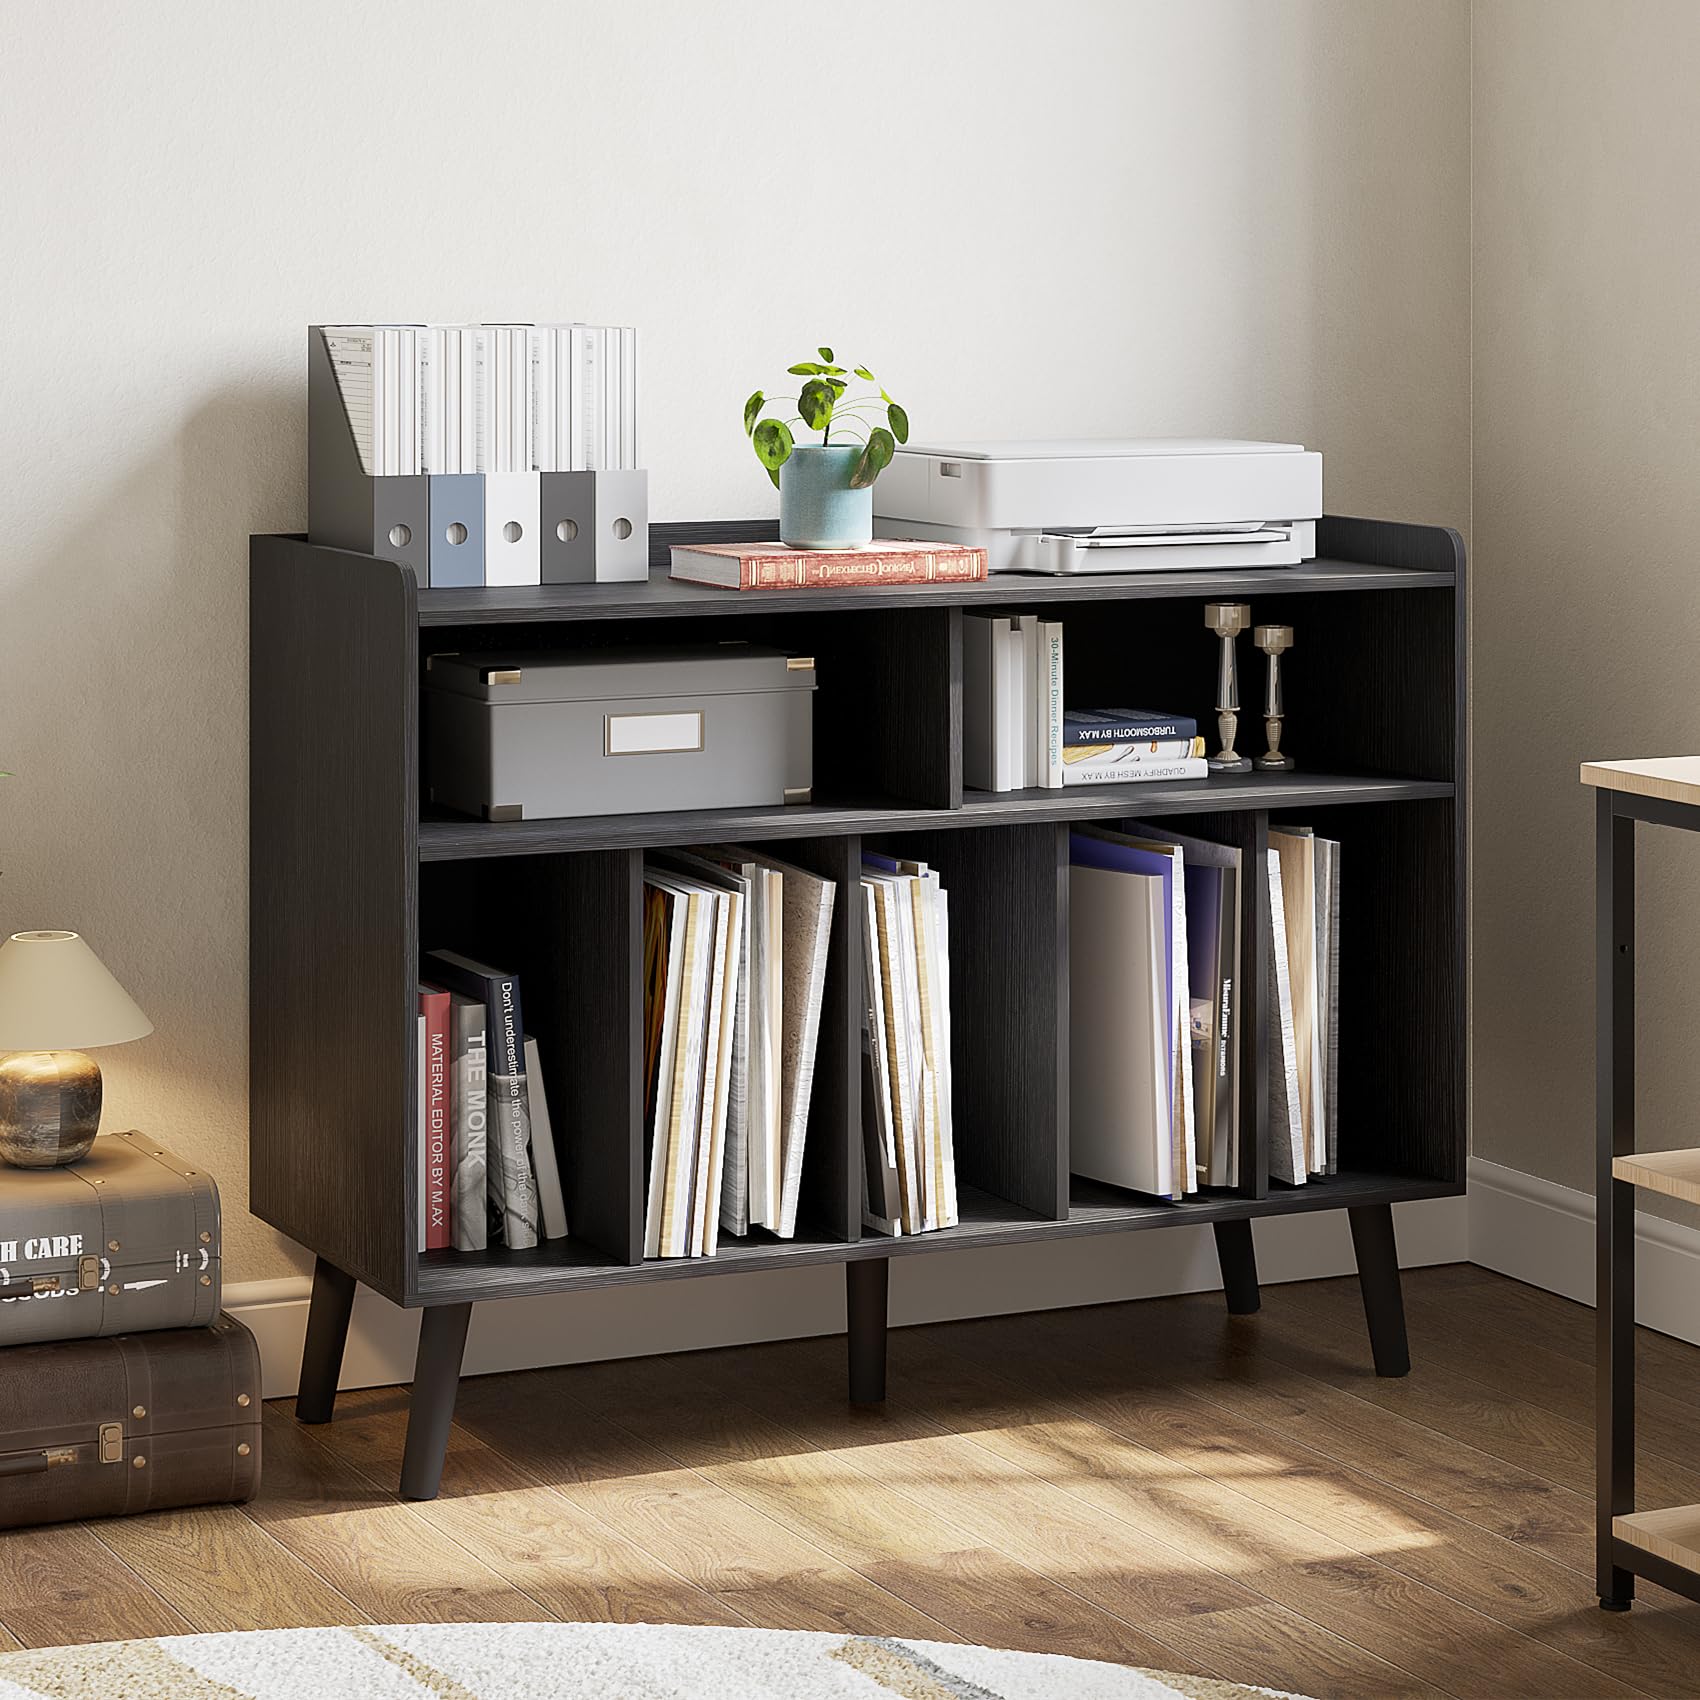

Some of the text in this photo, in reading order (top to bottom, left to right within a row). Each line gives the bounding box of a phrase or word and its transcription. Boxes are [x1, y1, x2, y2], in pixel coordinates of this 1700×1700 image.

[1049, 637, 1059, 766] 30-Minute Dinner Recipes
[1100, 729, 1112, 739] BY
[1113, 726, 1177, 738] TURBOSMOOTH
[1104, 771, 1116, 780] BY
[1117, 769, 1142, 779] MESH
[1143, 767, 1186, 777] QUADRIFY
[501, 982, 515, 1013] Don't
[504, 1016, 521, 1097] underestimate
[468, 1030, 486, 1168] THE MONK
[512, 1099, 522, 1118] the
[432, 1033, 443, 1227] MATERIAL EDITOR BY M.AX
[512, 1121, 523, 1157] power
[516, 1158, 526, 1170] of
[518, 1172, 528, 1191] the
[520, 1193, 529, 1219] dark
[24, 1234, 83, 1260] CARE
